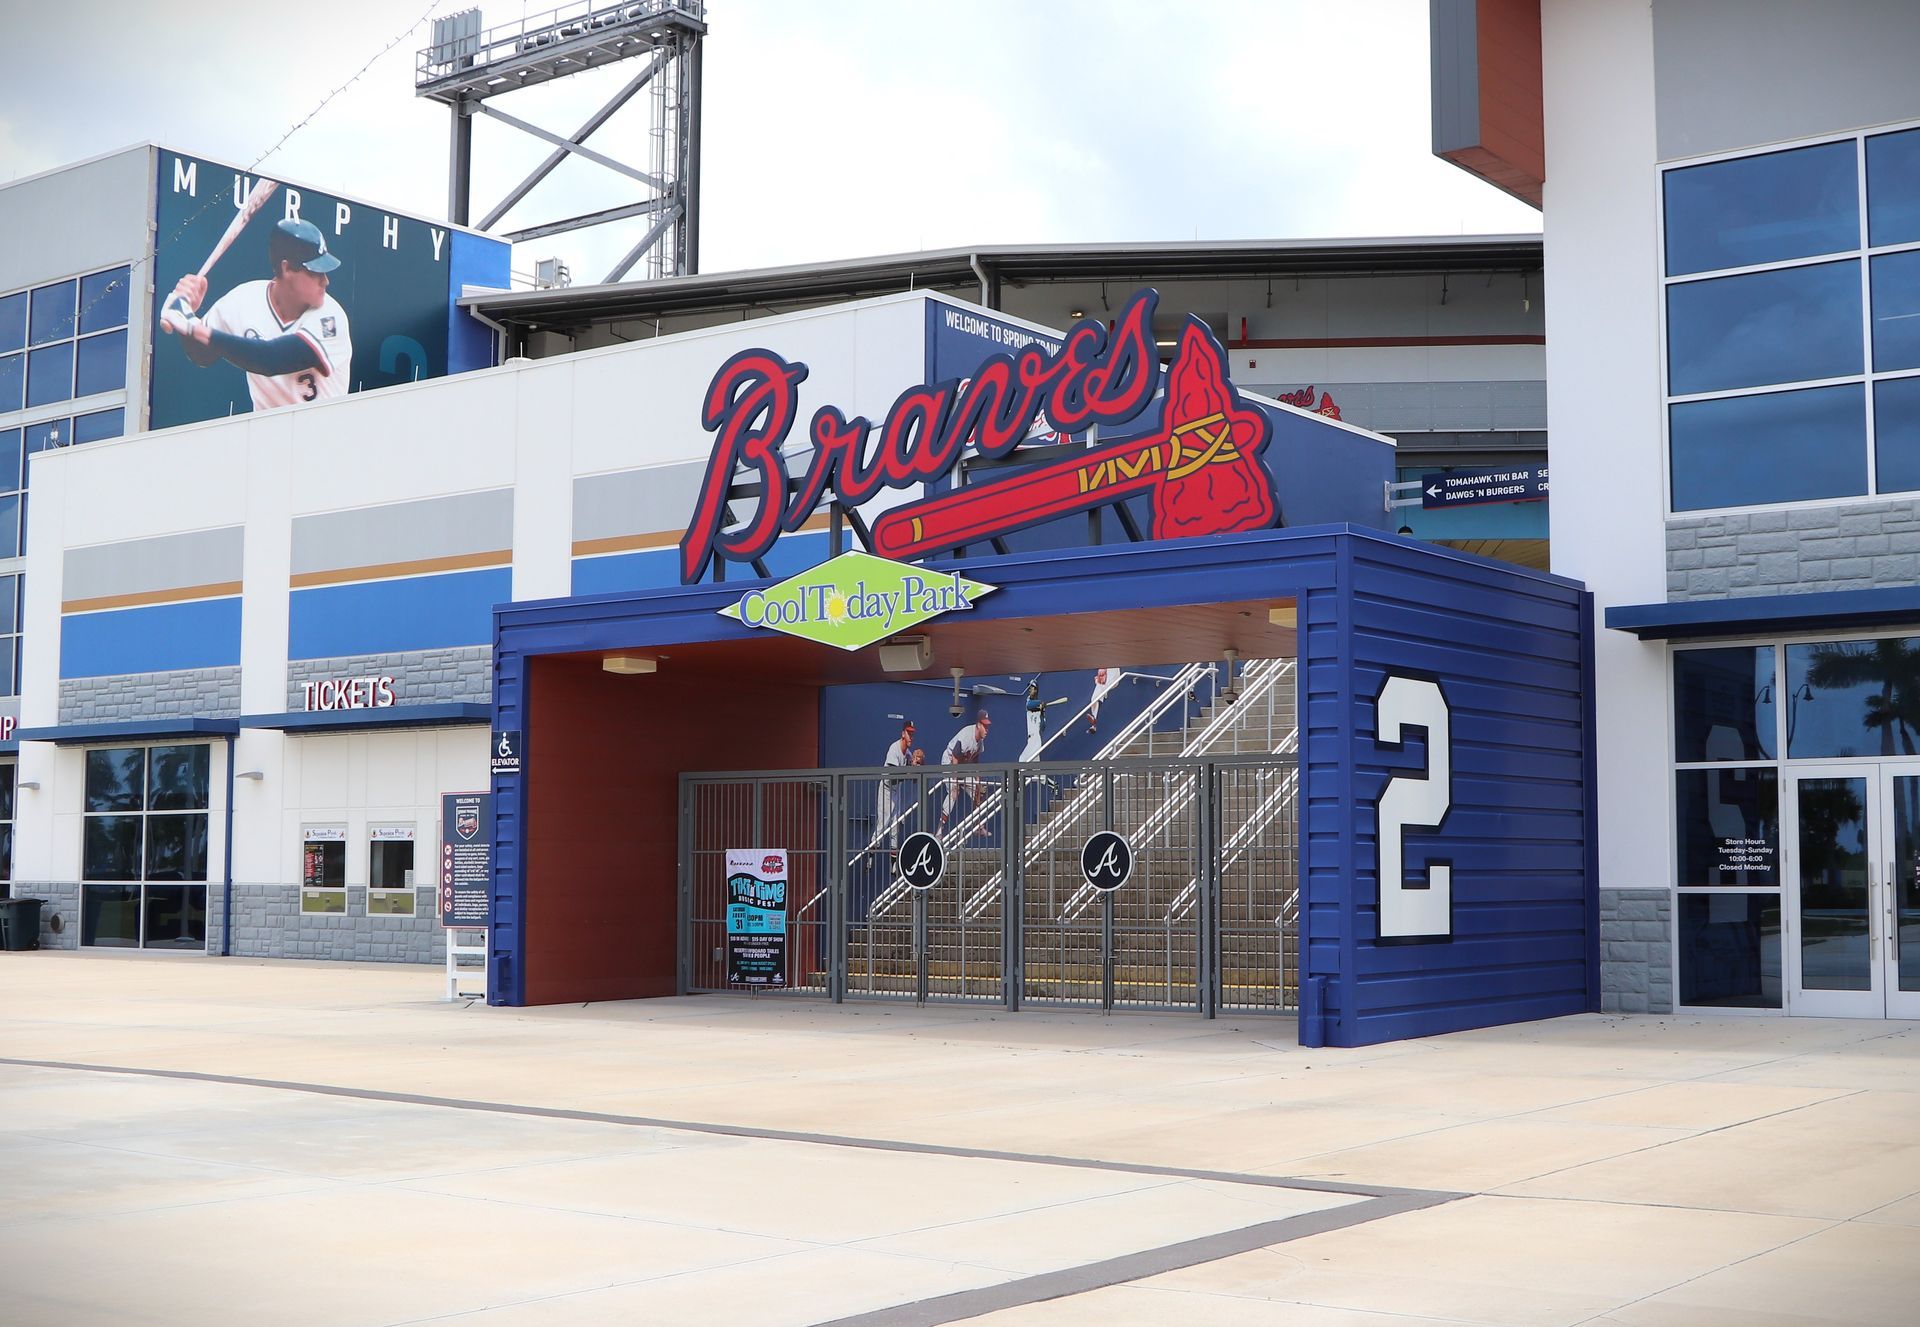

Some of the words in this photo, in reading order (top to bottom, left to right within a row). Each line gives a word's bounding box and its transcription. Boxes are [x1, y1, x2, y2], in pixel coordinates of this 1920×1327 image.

[173, 157, 446, 262] MURPHY
[945, 310, 989, 340] WELCOME
[991, 325, 1002, 343] TO
[297, 373, 318, 402] 3
[680, 288, 1159, 584] Braves
[1445, 476, 1493, 488] TOMAHAWK
[1494, 473, 1510, 483] TIKI
[1511, 471, 1529, 481] BAR
[1445, 489, 1475, 501] DAWGS
[1486, 485, 1525, 496] BURGERS
[902, 571, 973, 614] Park
[302, 677, 396, 711] TICKETS
[491, 758, 520, 767] ELEVATOR
[1374, 673, 1453, 940] 2
[1718, 846, 1774, 855] Tuesday-Sunday
[1744, 864, 1771, 872] Monday
[757, 899, 776, 908] FEST
[736, 919, 743, 930] 31
